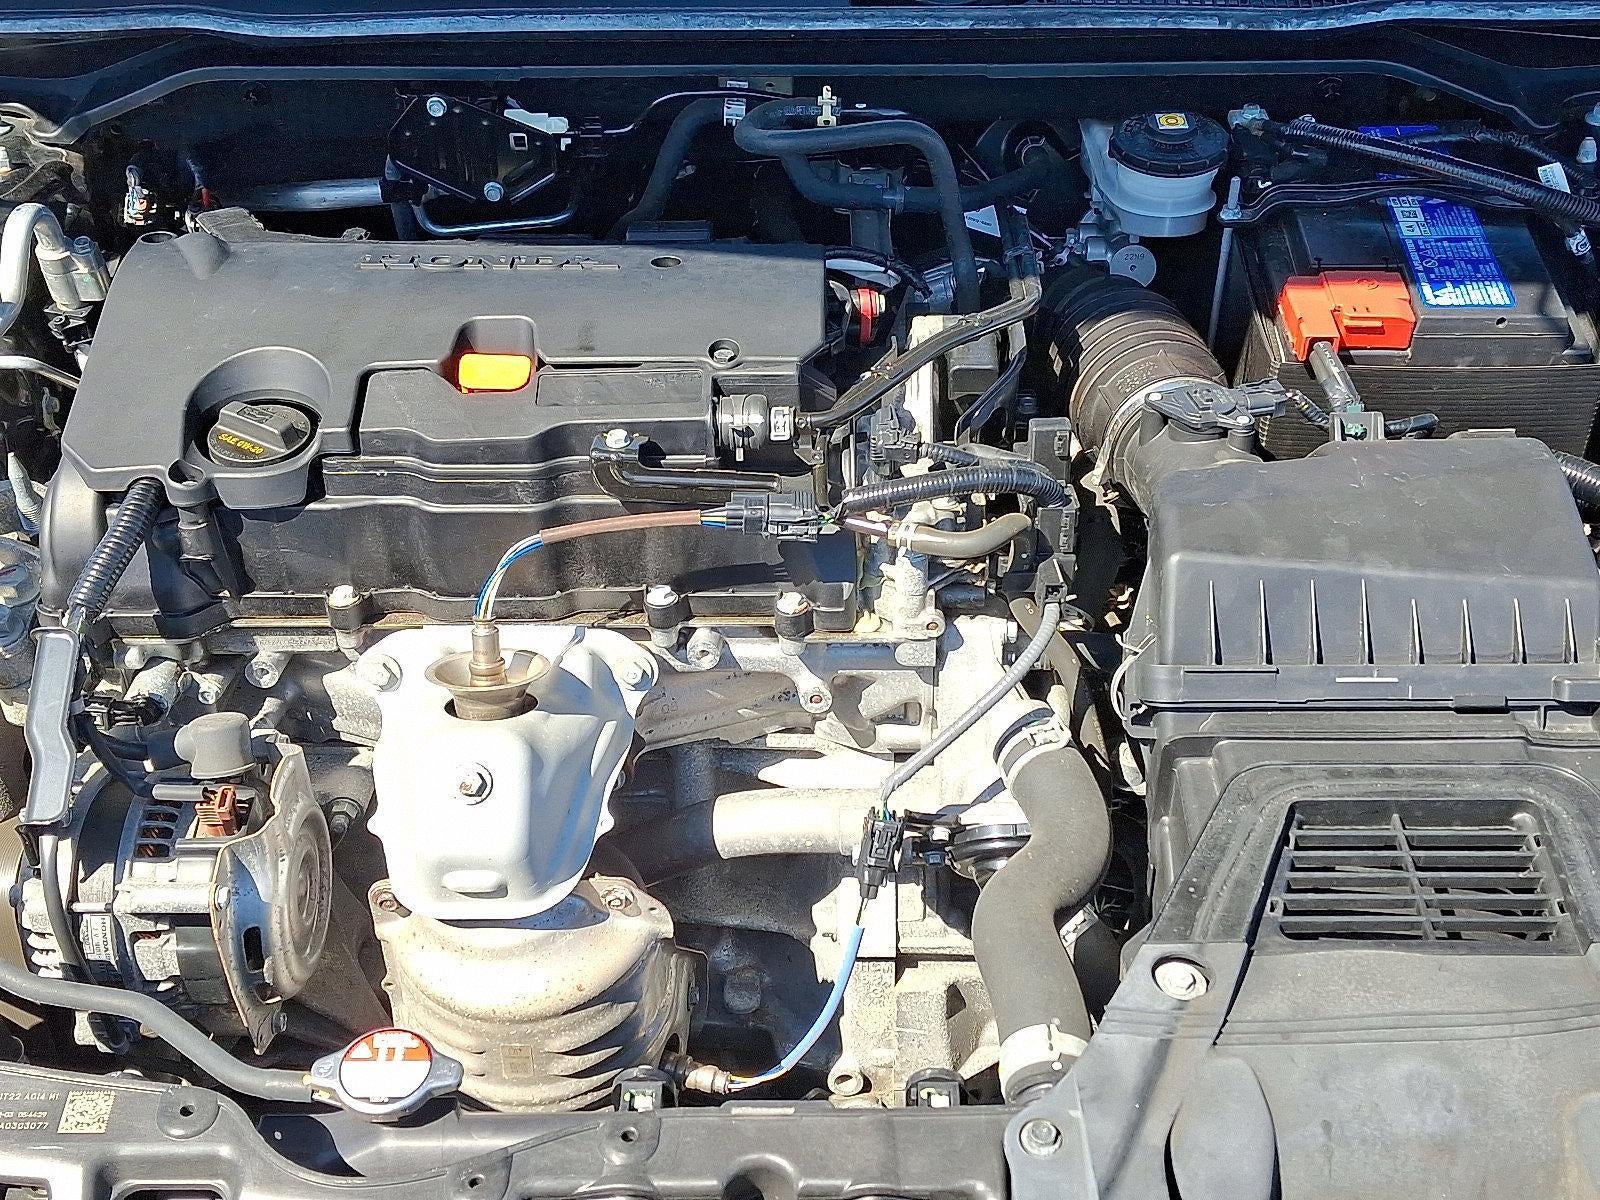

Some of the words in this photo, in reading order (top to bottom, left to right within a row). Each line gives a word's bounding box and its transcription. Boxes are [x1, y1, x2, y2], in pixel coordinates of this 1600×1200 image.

[360, 254, 621, 270] HONDA
[218, 432, 239, 445] SAE
[100, 917, 110, 953] HONDA
